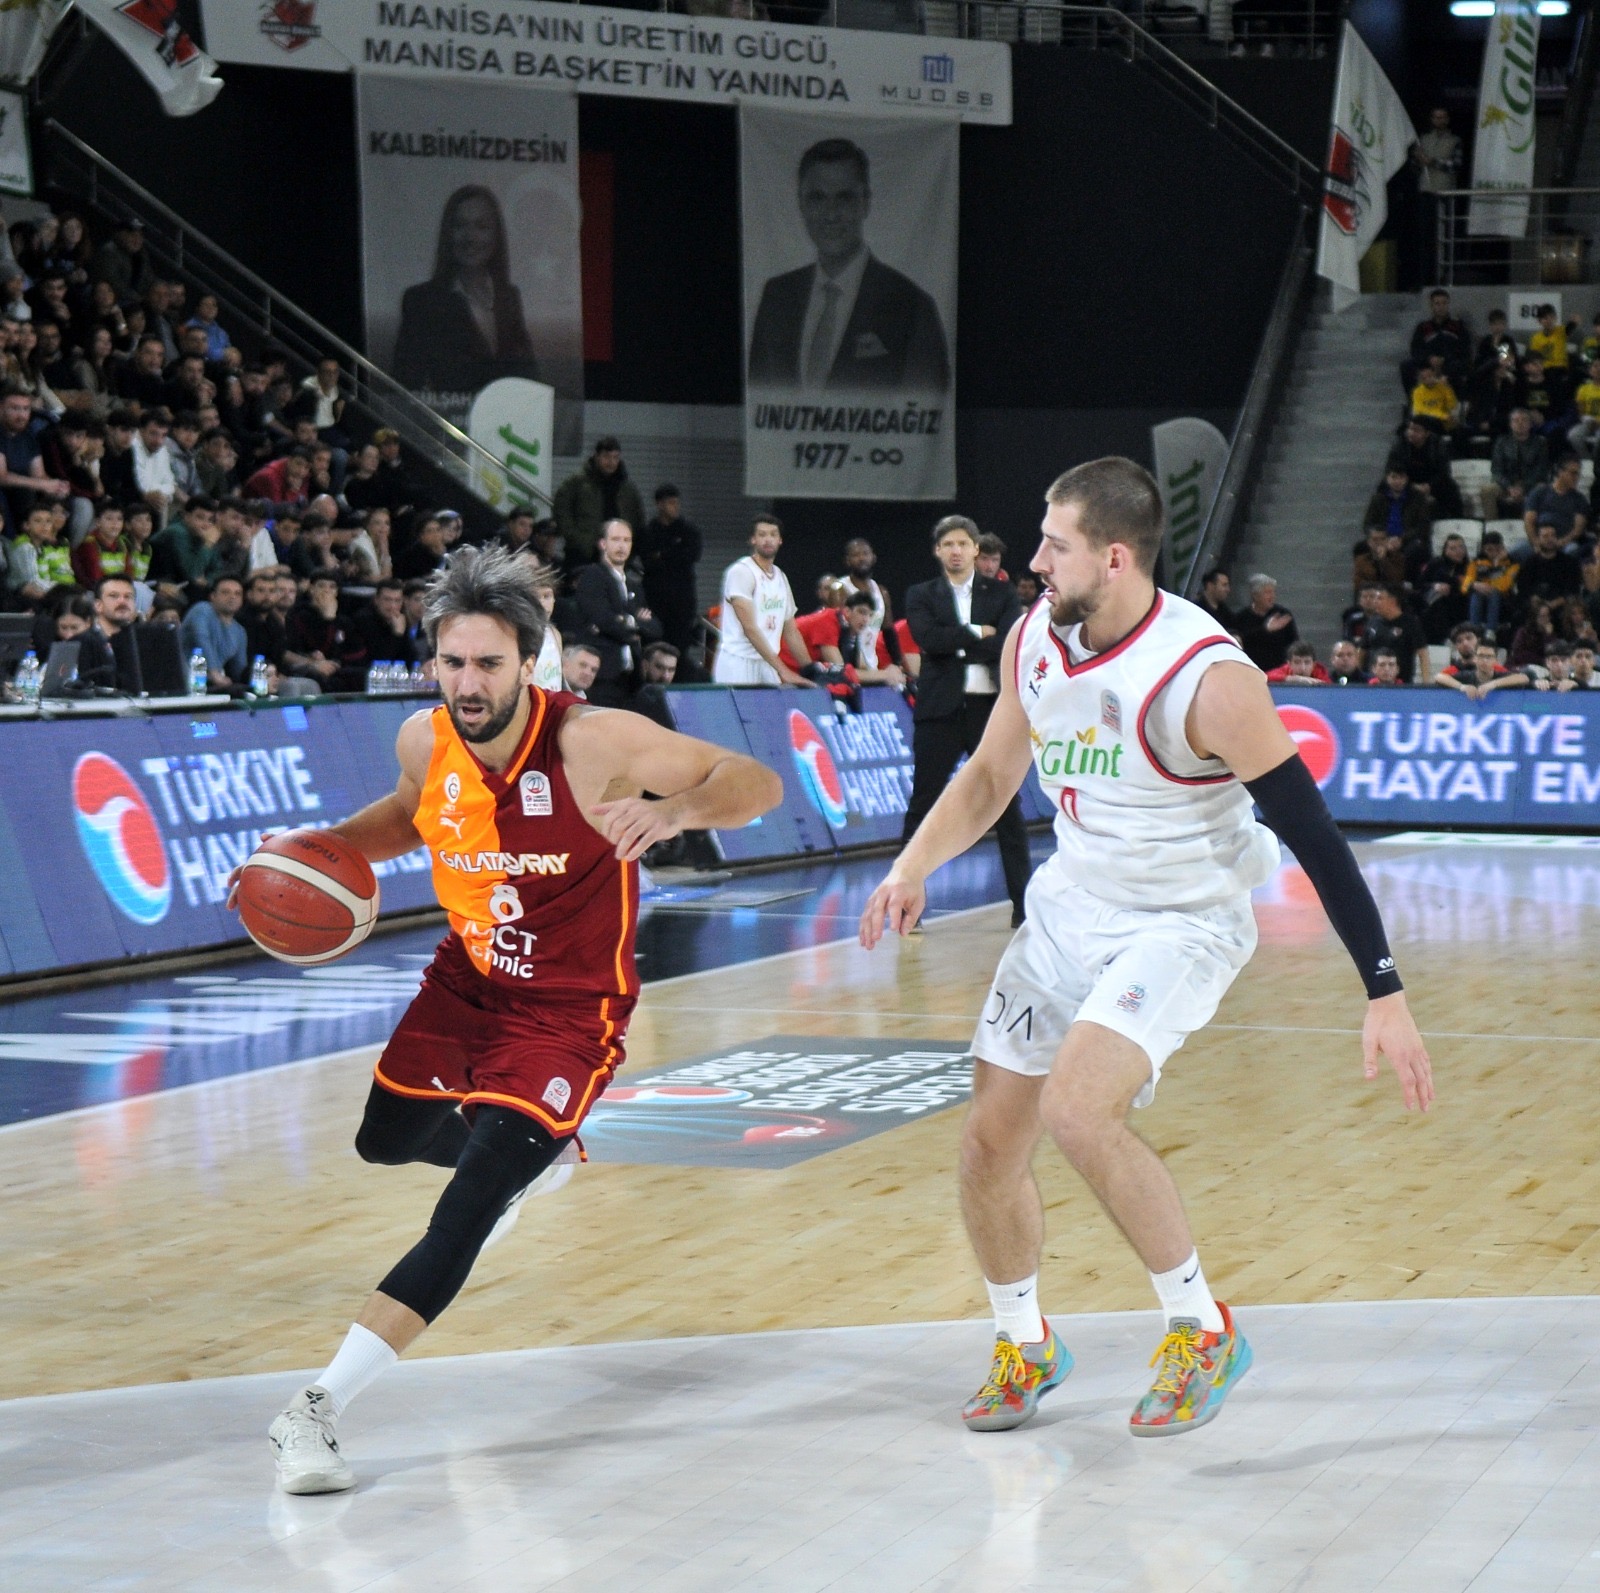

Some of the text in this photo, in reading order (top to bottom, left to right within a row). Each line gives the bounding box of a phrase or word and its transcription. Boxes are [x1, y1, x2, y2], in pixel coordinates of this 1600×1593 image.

[378, 2, 838, 69] MANİSA'NIN ÜRETİM GÜCÜ,
[364, 37, 850, 102] MANİSA BASKET'İN YANINDA
[368, 126, 568, 163] KALBİMİZDESİN
[754, 401, 943, 435] UNUTMAYACAĞIZ
[1041, 728, 1124, 778] Glint
[1349, 710, 1587, 756] TÜRKİYE
[142, 746, 321, 825] TÜRKİYE
[840, 766, 909, 818] HAYAT
[1342, 758, 1519, 801] HAYAT
